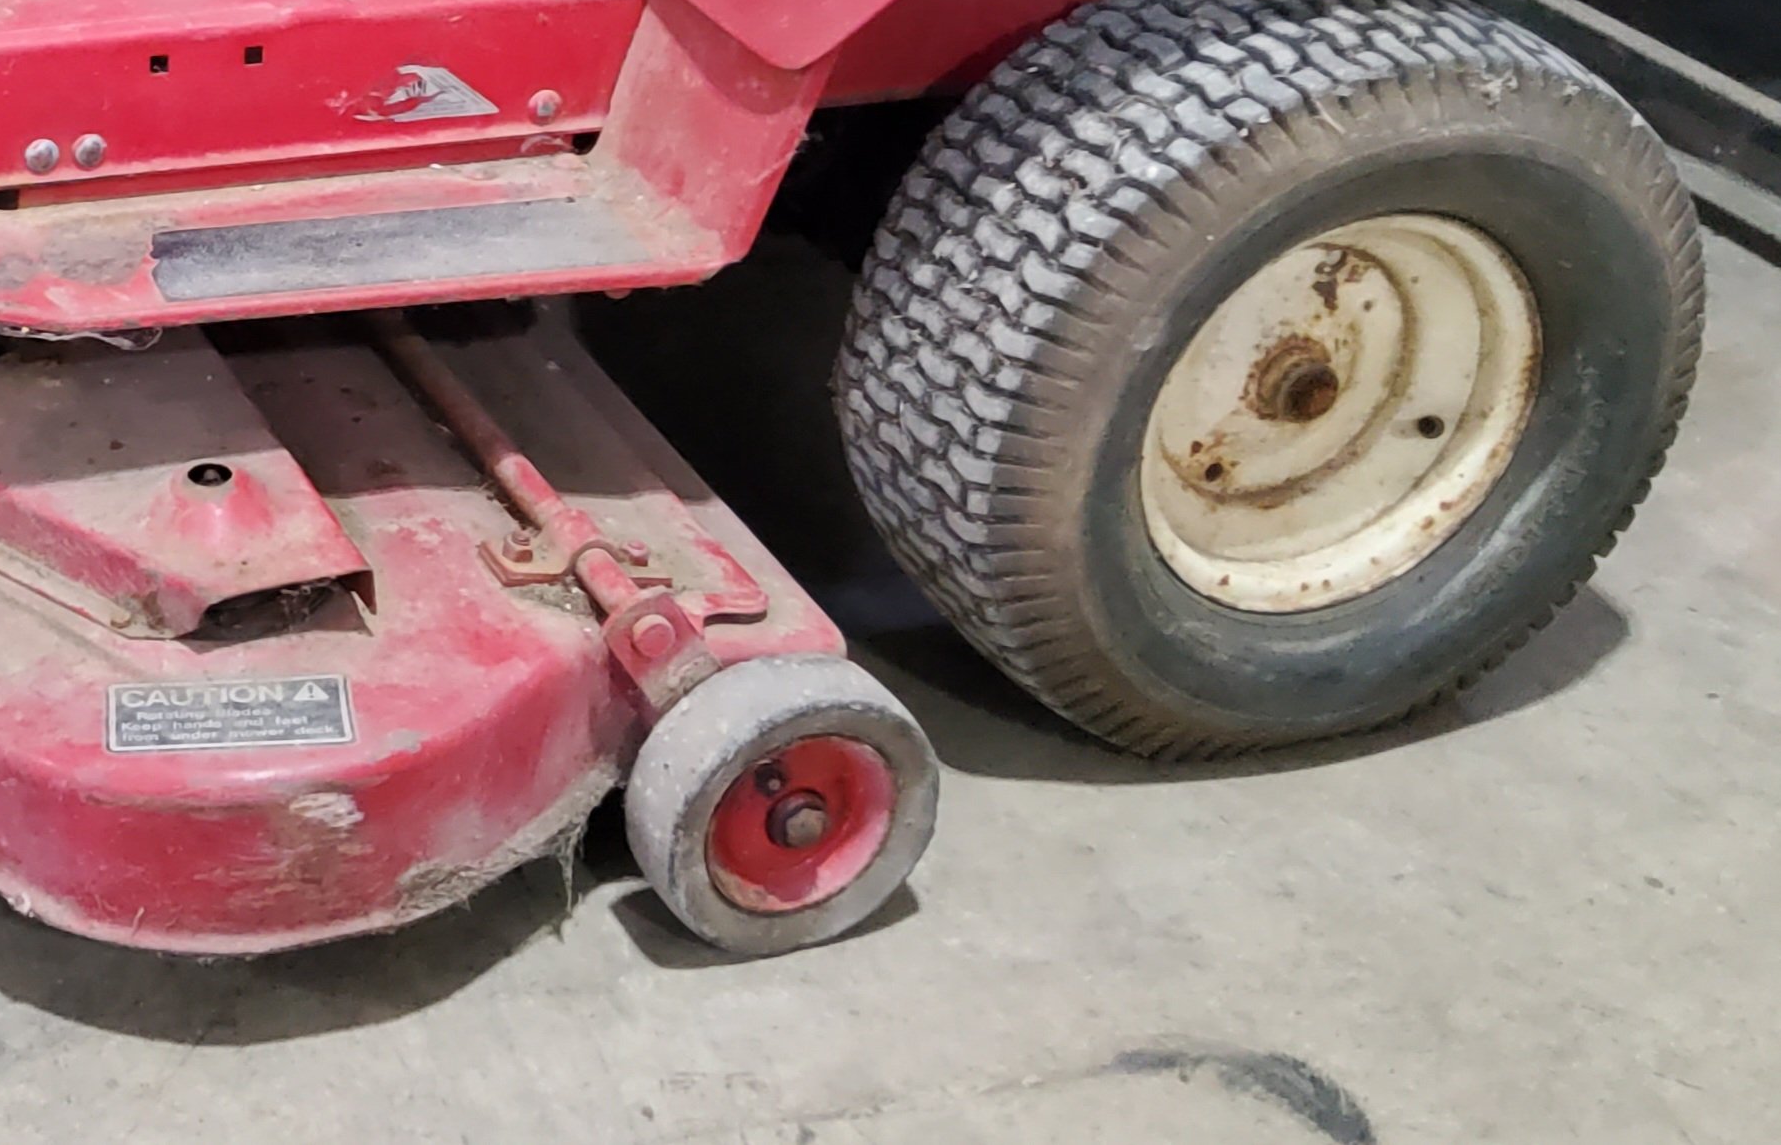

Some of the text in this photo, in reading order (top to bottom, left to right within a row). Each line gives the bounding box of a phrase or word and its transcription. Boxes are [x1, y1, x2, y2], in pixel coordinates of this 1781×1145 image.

[121, 685, 283, 708] CAUTION
[121, 714, 309, 733] Keep hands and feet
[122, 731, 160, 743] from
[170, 729, 217, 741] under
